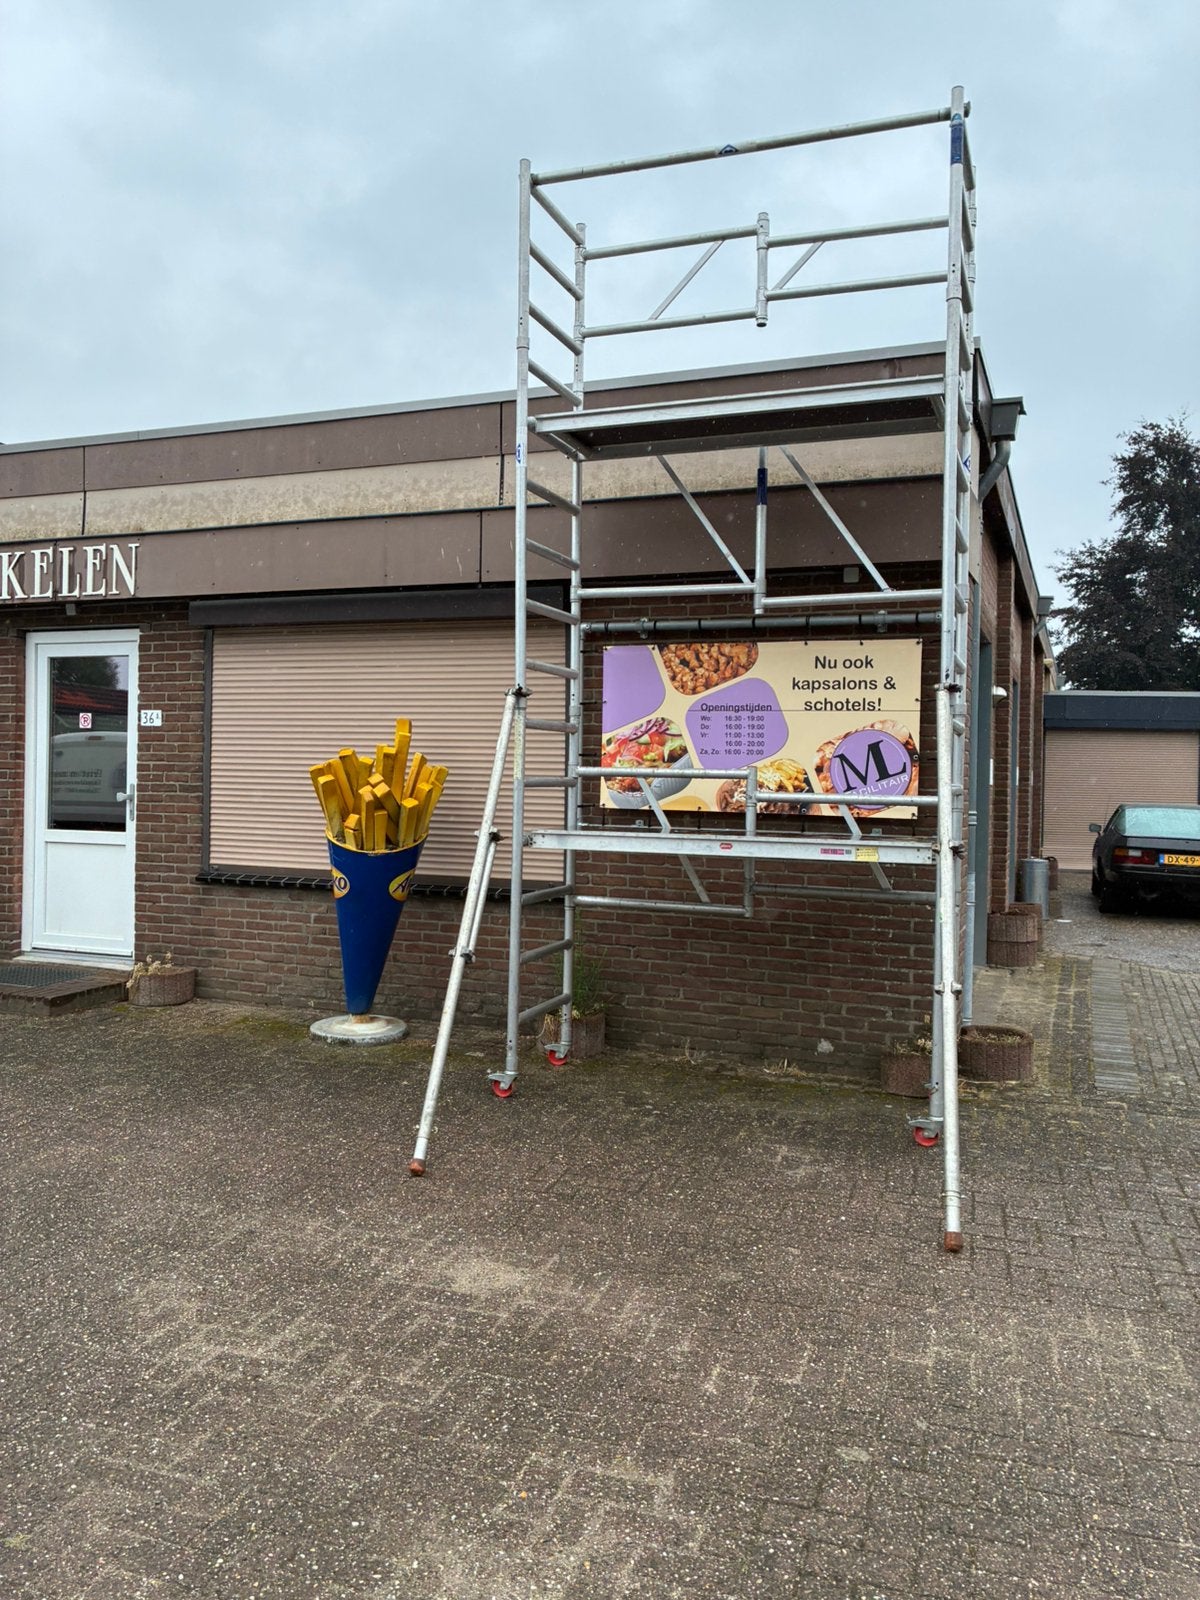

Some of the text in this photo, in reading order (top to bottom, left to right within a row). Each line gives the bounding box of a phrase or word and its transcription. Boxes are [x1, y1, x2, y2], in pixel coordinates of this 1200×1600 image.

[0, 543, 140, 600] KELEN
[814, 655, 874, 669] Nu ook
[791, 675, 897, 694] kapsalons &
[700, 702, 773, 713] Openingstijden
[803, 697, 882, 712] schotels!
[833, 740, 907, 793] ML
